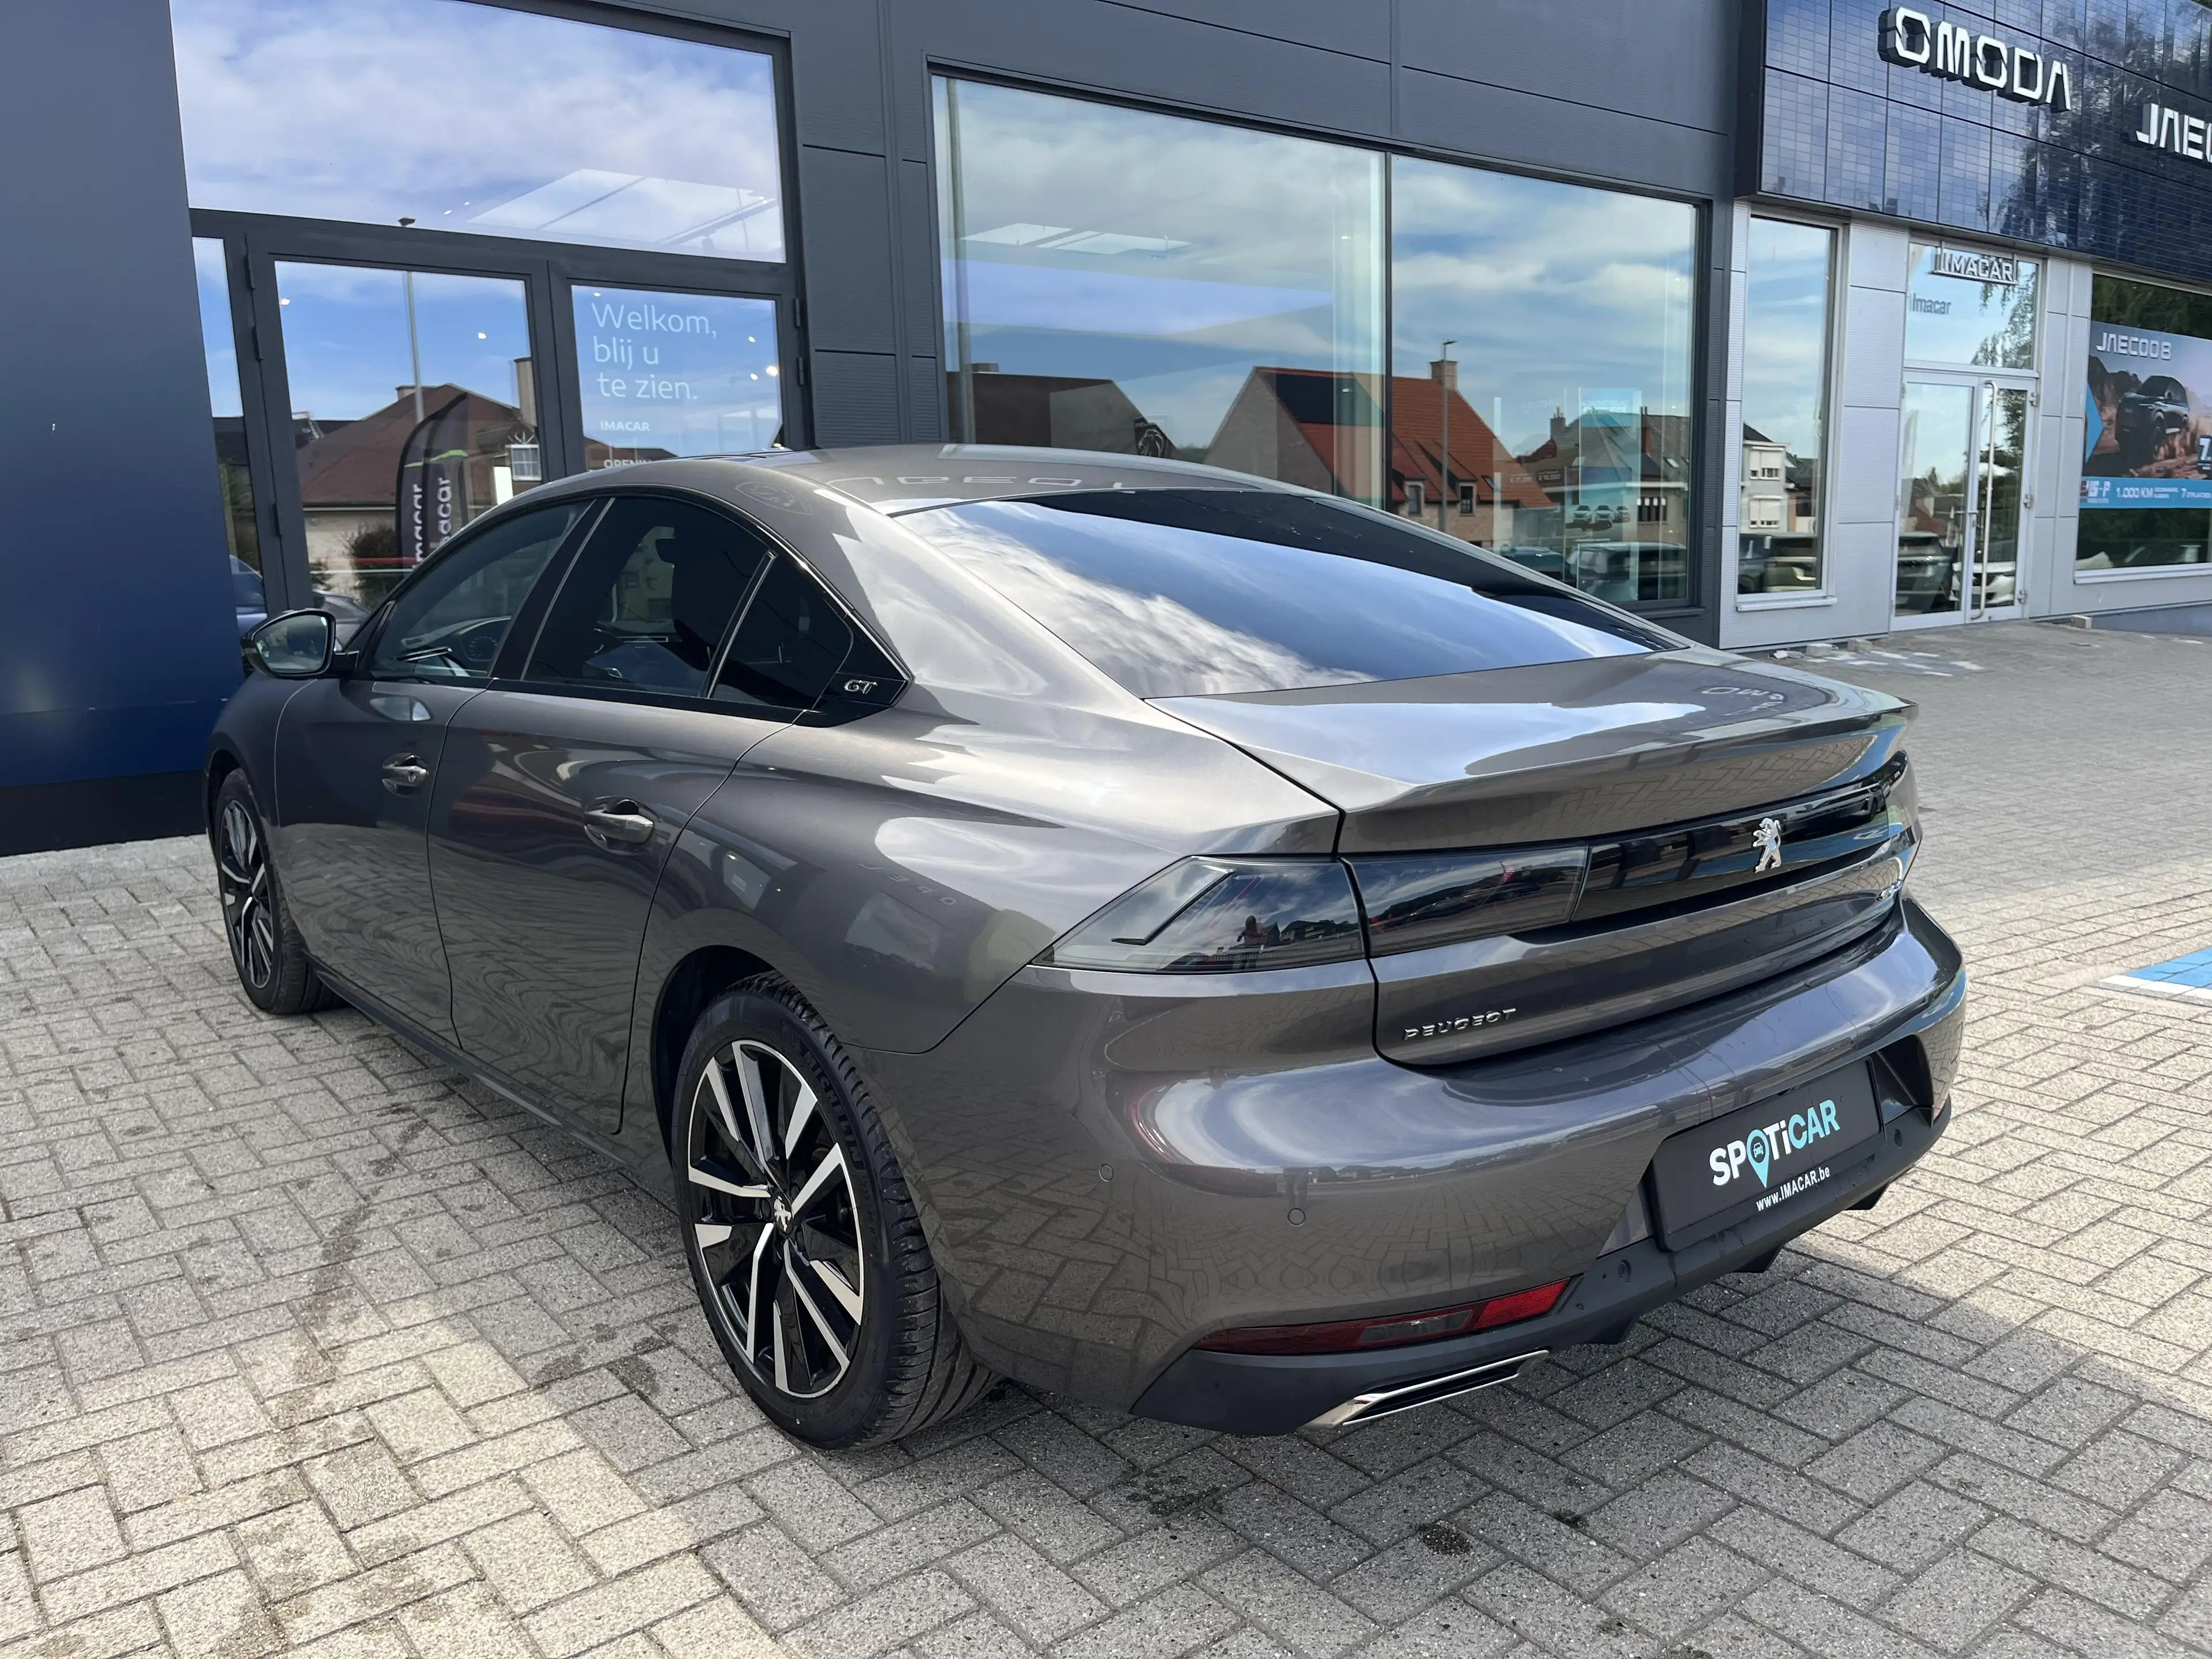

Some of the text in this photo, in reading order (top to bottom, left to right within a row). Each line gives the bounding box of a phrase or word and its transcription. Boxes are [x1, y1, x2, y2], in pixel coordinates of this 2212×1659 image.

[1894, 7, 2071, 111] OMODA
[1944, 253, 2013, 281] IMACAR
[1912, 293, 1952, 315] Imacar
[591, 302, 717, 339] Welkom,
[593, 336, 660, 370] blij u
[597, 372, 698, 400] te zien.
[600, 420, 650, 432] IMACAR
[843, 679, 878, 695] GT
[1404, 1007, 1516, 1041] PEUGEOT
[1756, 1166, 1831, 1211] www.IMACAR.be
